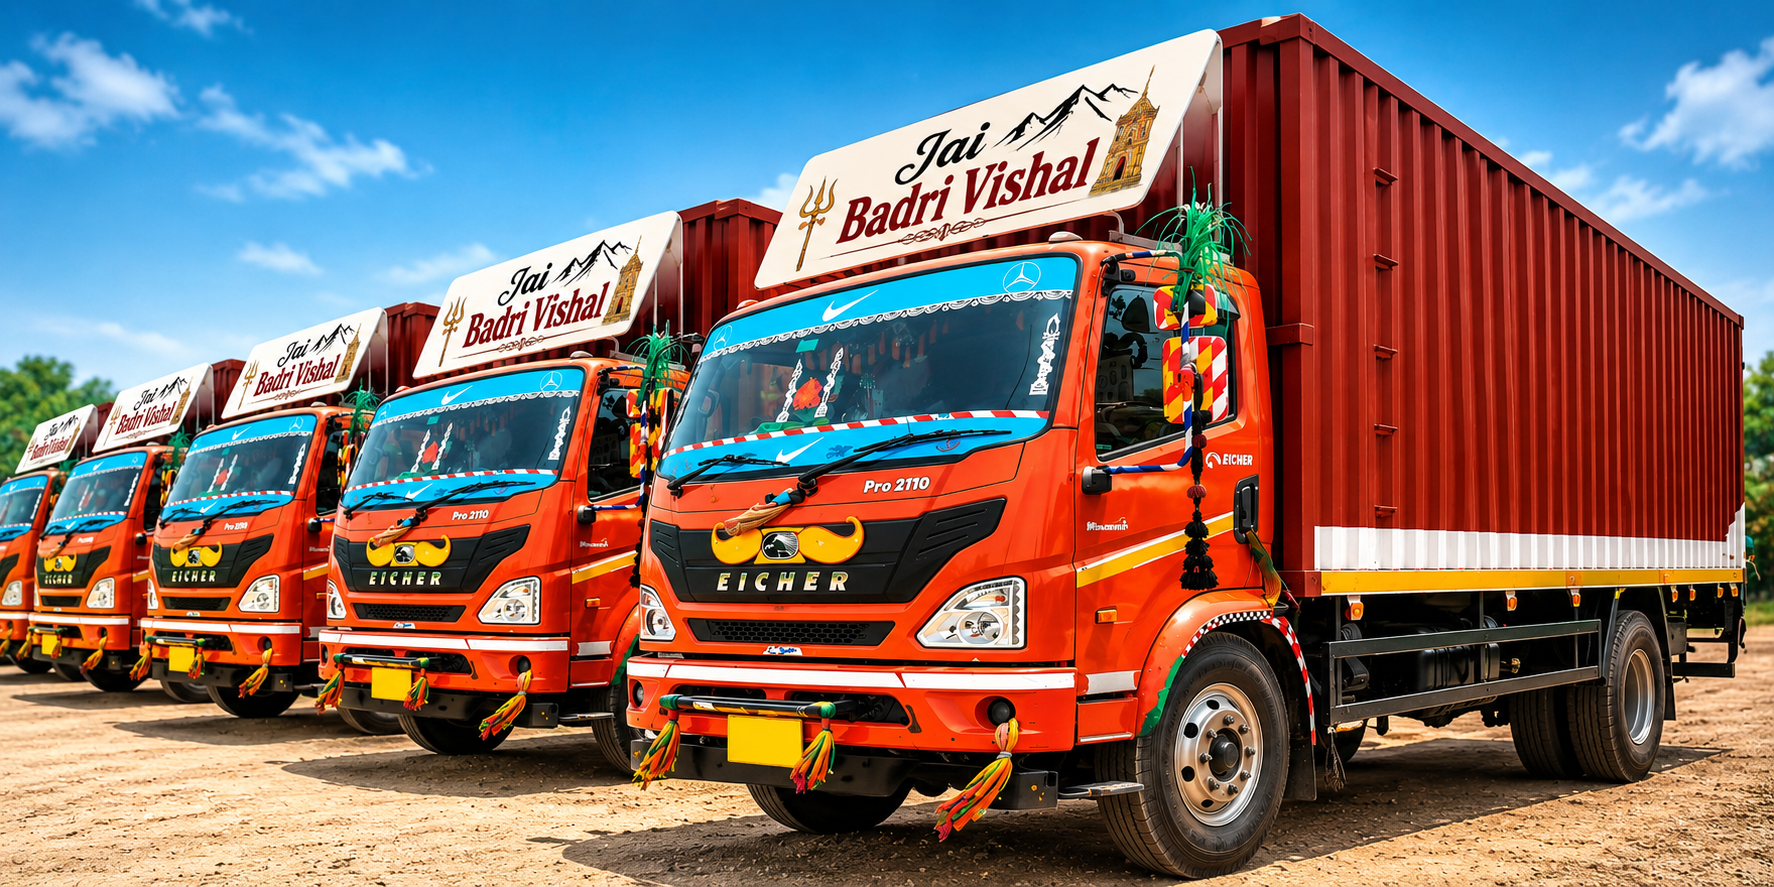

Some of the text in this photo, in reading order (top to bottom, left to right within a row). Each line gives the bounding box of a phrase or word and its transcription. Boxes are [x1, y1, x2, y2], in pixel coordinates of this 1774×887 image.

[894, 121, 991, 186] Jai
[835, 136, 1101, 245] Badri Vishal
[496, 262, 553, 307] Jai
[461, 280, 611, 349] Badri Vishal
[277, 338, 311, 368] Jai
[253, 353, 341, 397] Badri Vishal
[1222, 453, 1253, 466] EICHER
[863, 476, 931, 494] Pro 2110
[451, 509, 490, 521] Pro 2110
[171, 570, 217, 583] EICHER
[368, 571, 442, 586] EICHER
[716, 571, 850, 592] EICHER
